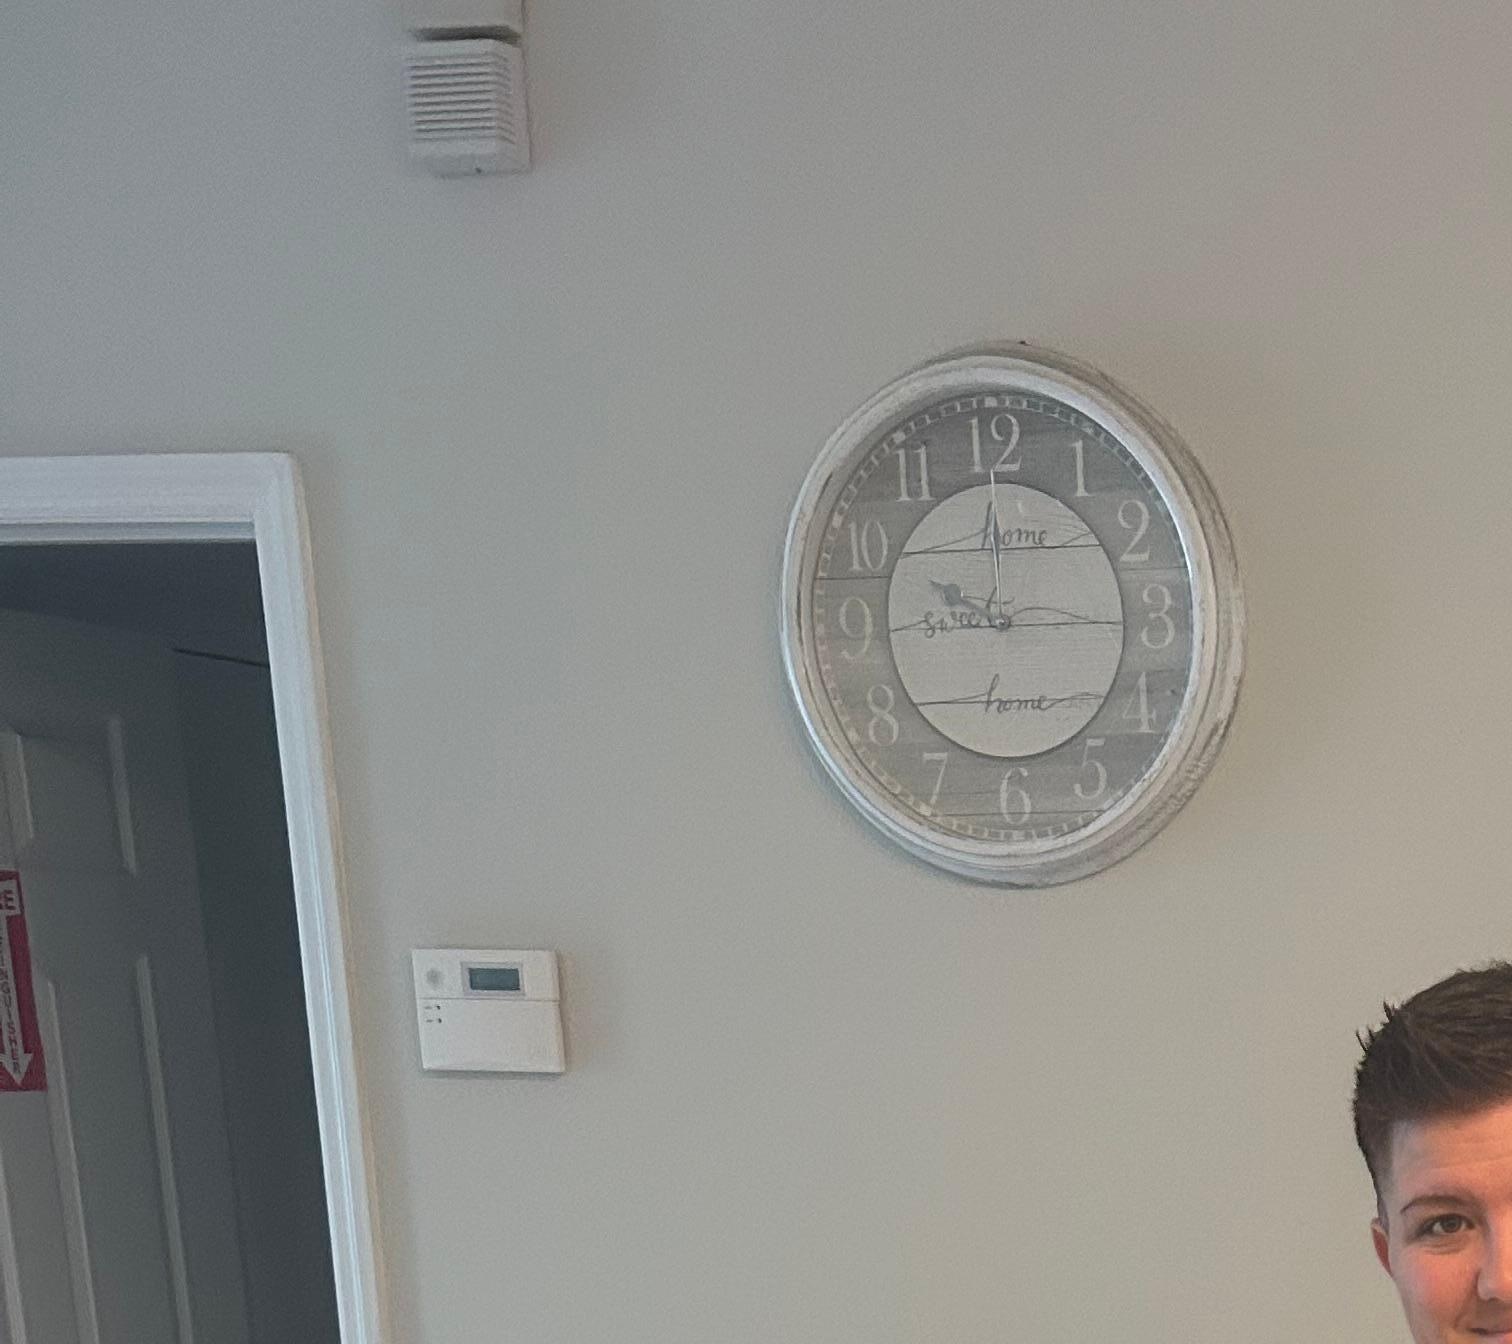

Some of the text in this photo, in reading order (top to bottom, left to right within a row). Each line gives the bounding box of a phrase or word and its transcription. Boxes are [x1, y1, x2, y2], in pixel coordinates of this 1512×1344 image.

[899, 442, 934, 502] 11
[968, 413, 1022, 473] 12
[1072, 440, 1089, 498] 1
[849, 518, 889, 572] 10
[1117, 500, 1151, 563] 2
[838, 598, 875, 664] 9
[1141, 583, 1175, 649] 3
[867, 684, 900, 747] 8
[984, 673, 1053, 715] home
[1123, 671, 1157, 734] 4
[922, 751, 950, 817] 7
[1000, 767, 1032, 824] 6
[1073, 738, 1108, 798] 5
